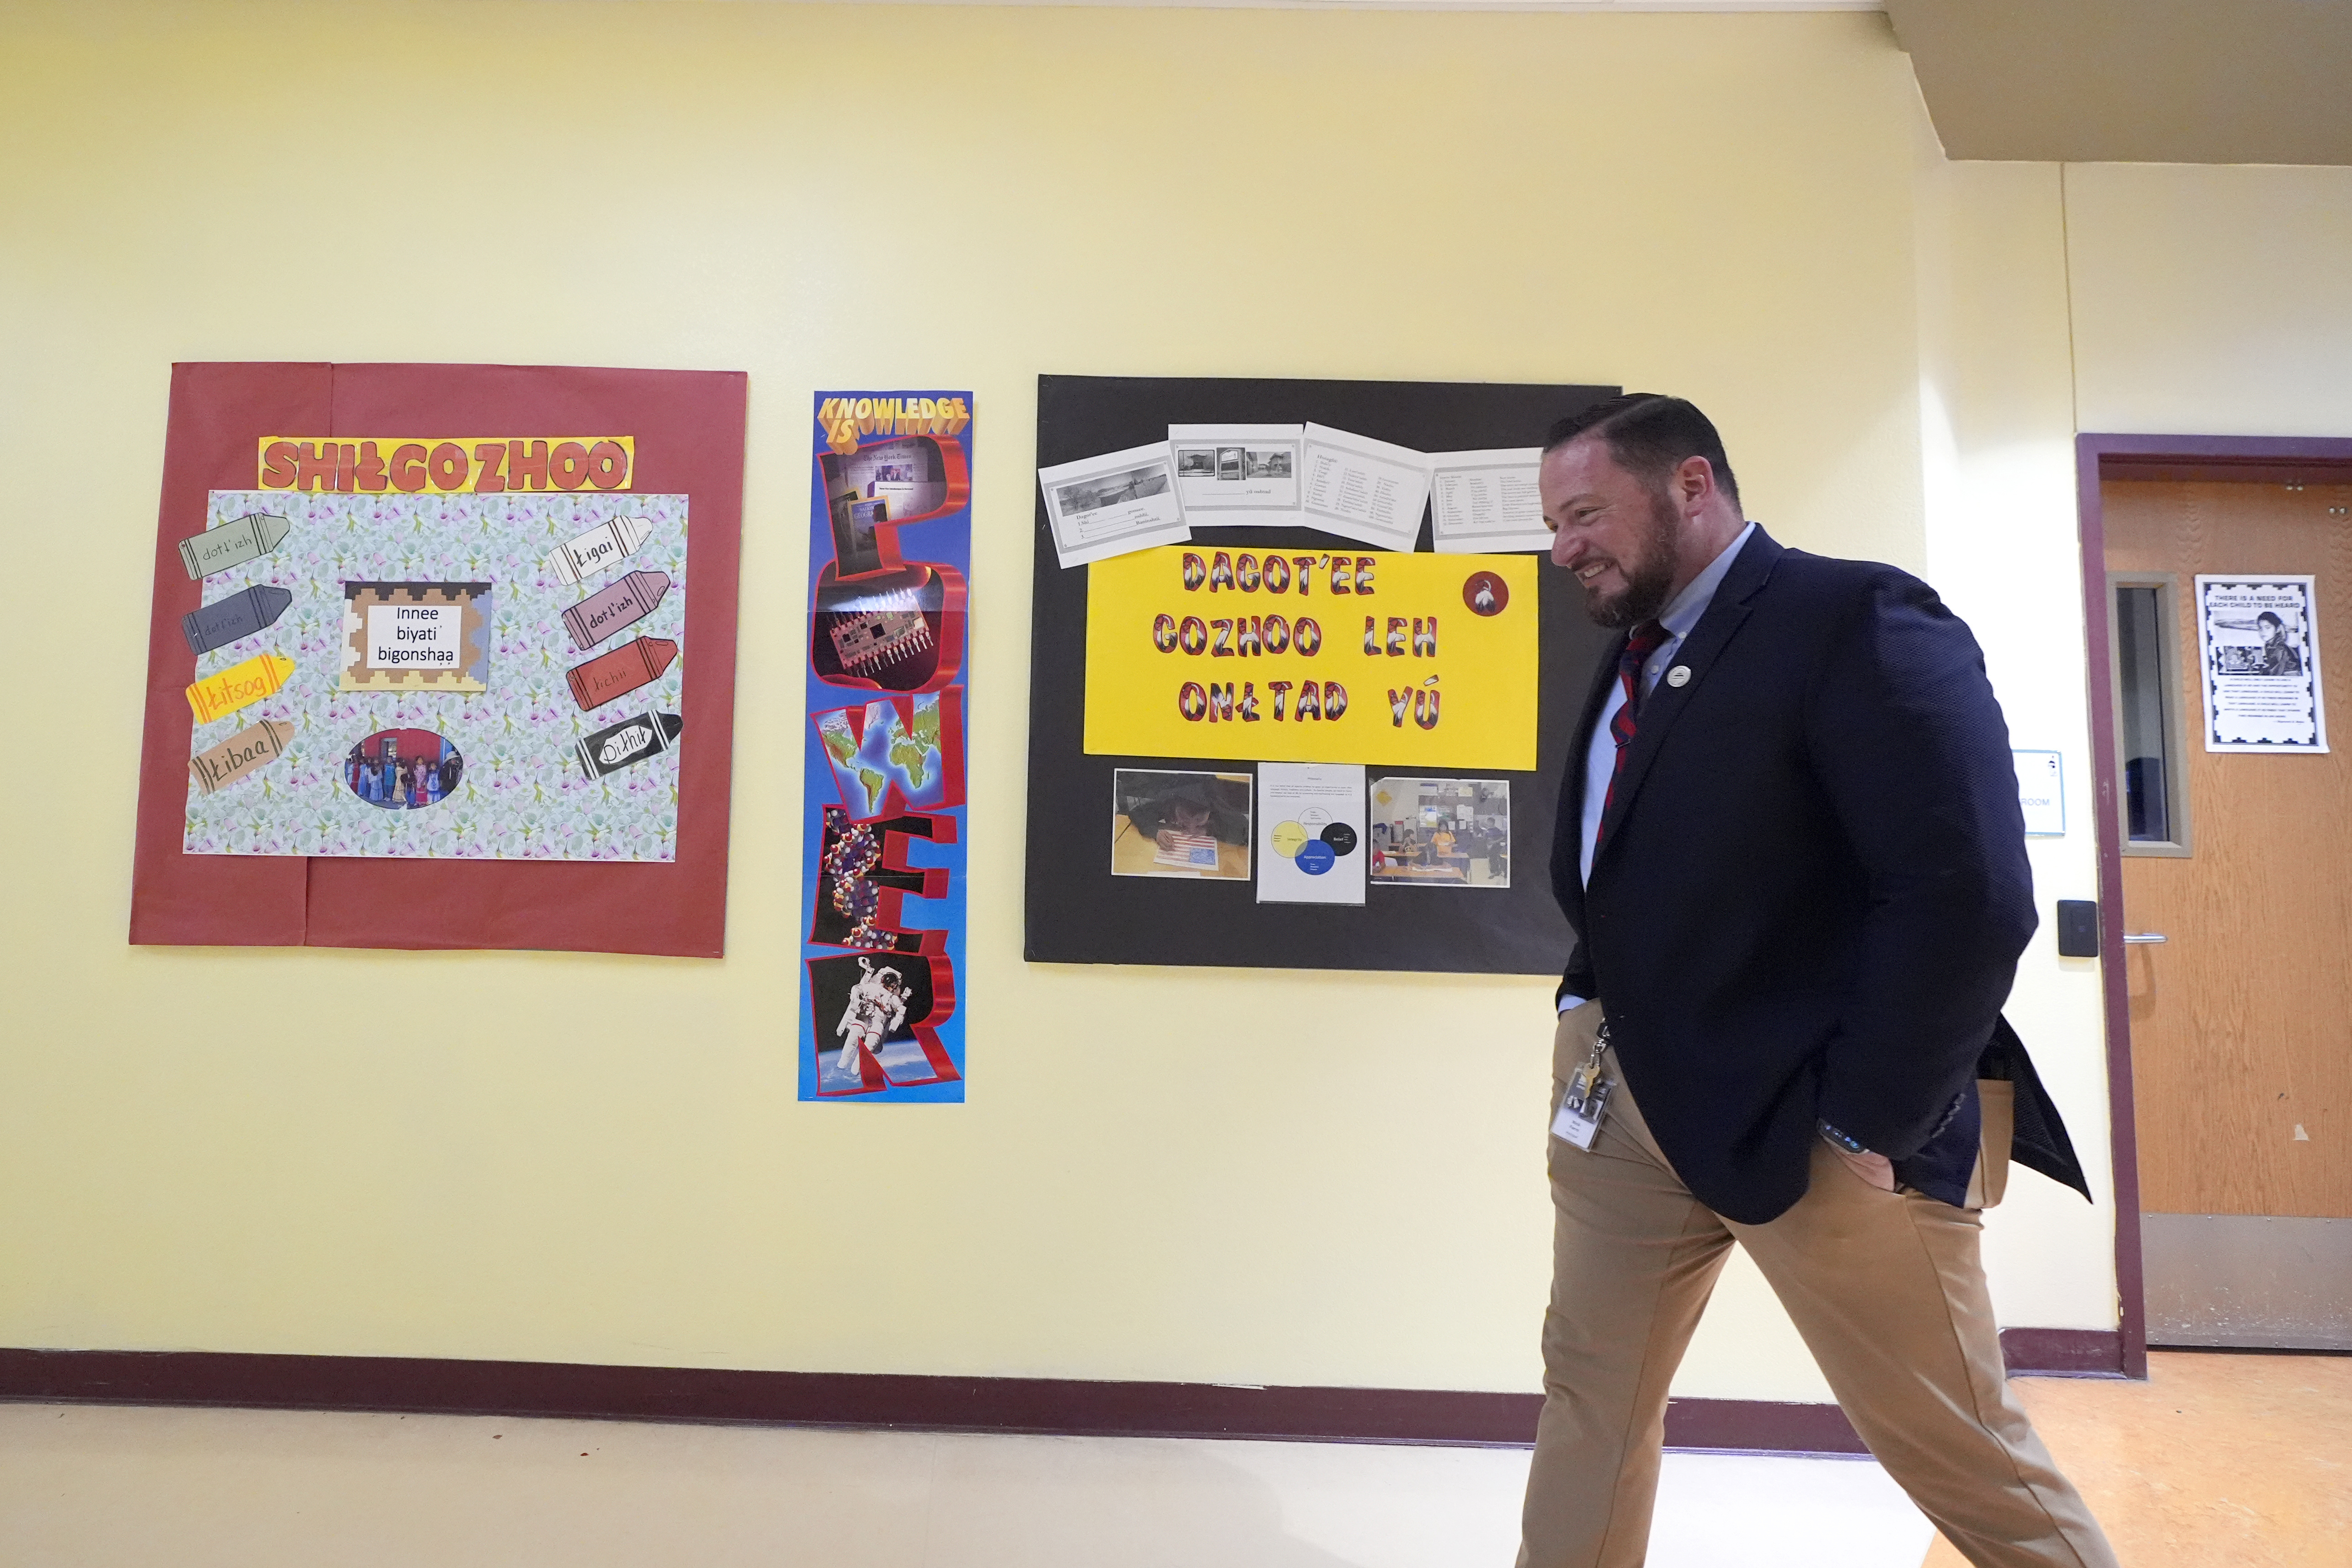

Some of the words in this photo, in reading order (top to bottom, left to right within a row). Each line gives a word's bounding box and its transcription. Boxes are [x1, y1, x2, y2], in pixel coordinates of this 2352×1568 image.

[817, 397, 970, 429] KNOWLEDGE
[825, 419, 857, 449] IS
[853, 510, 874, 520] GEOGRA
[1182, 551, 1376, 596] DAGOT'EE
[397, 607, 438, 620] Innee
[1152, 614, 1322, 657] GOZHOO
[1363, 615, 1437, 657] LEH
[1387, 674, 1440, 729] YÚ
